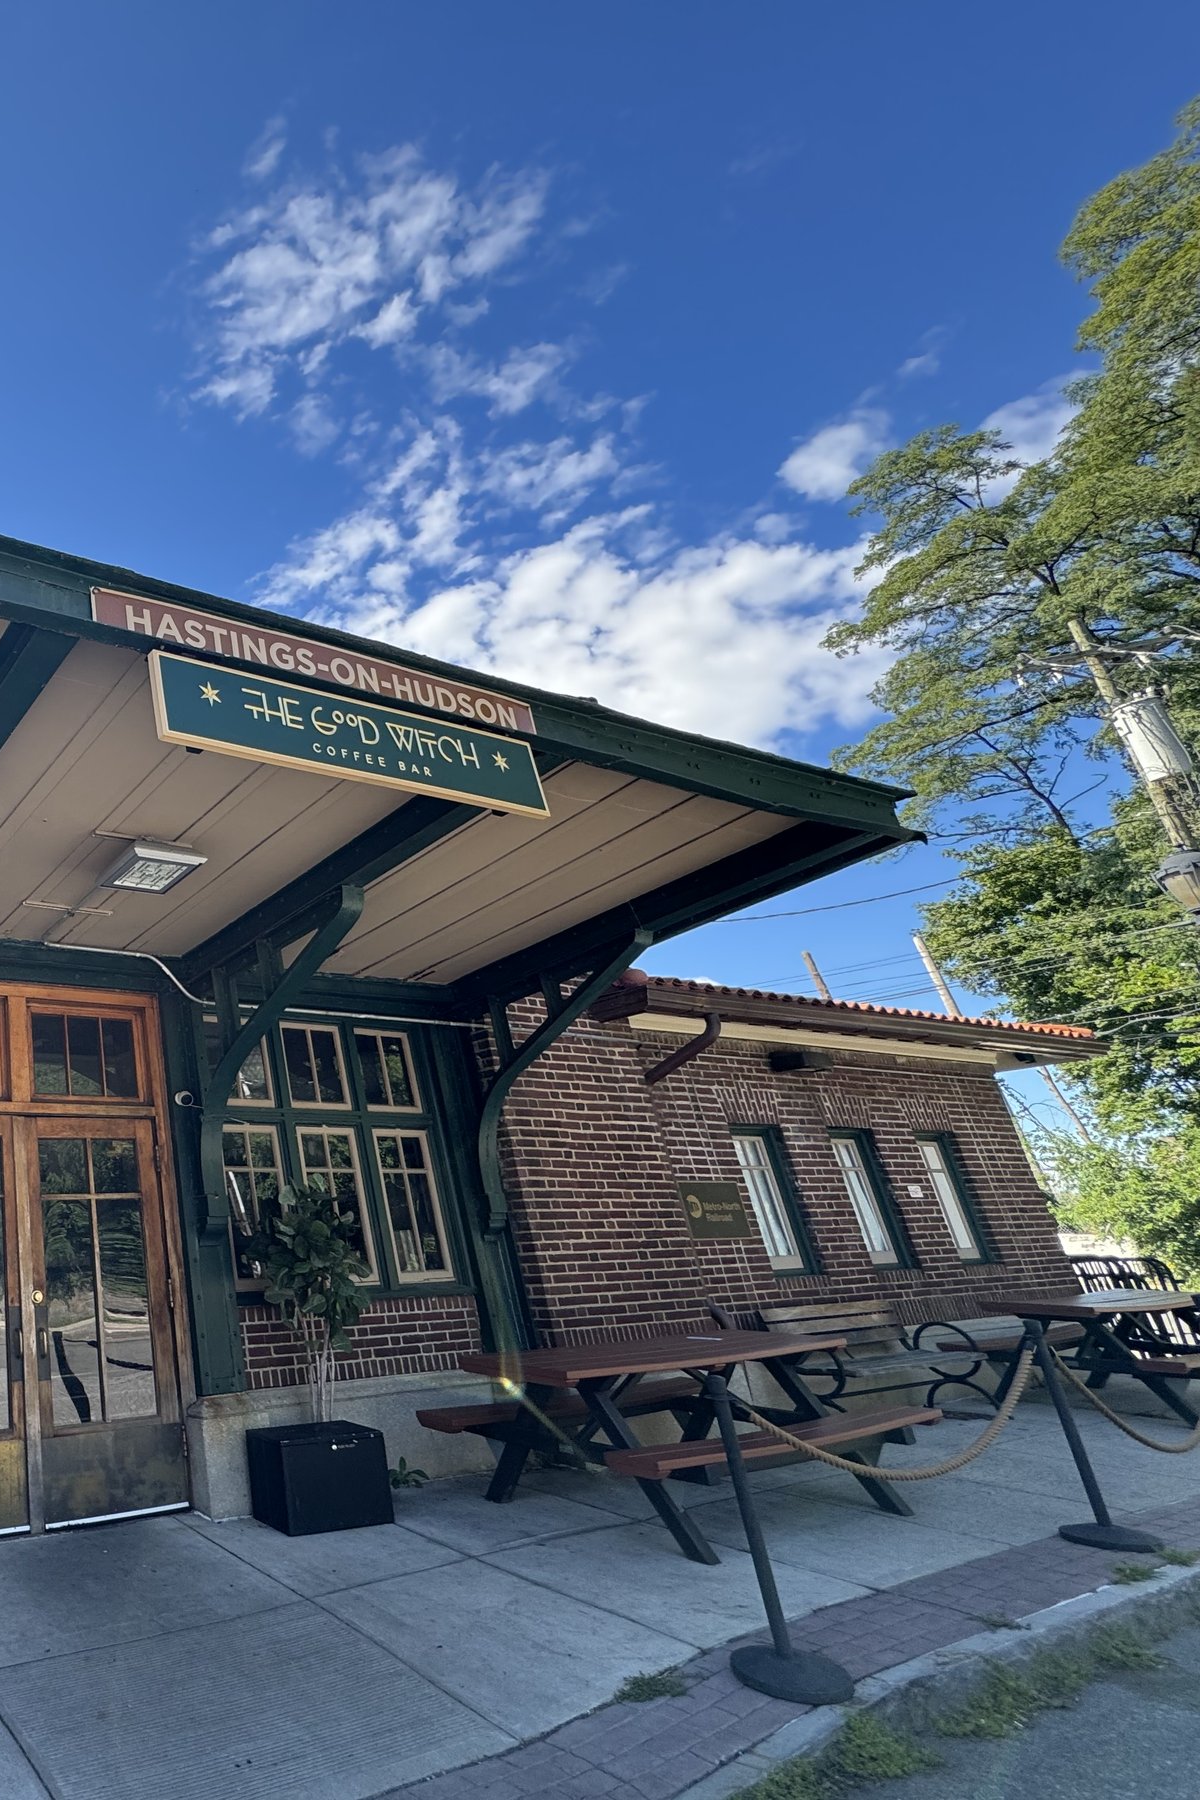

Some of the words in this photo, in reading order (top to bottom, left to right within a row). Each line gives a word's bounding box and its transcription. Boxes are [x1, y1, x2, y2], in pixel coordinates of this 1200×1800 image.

[125, 604, 518, 730] HASTINGS-ON-HUDSON
[241, 687, 305, 730] THE
[385, 722, 481, 769] WITCH
[312, 742, 386, 768] COFFEE
[398, 760, 433, 777] BAR
